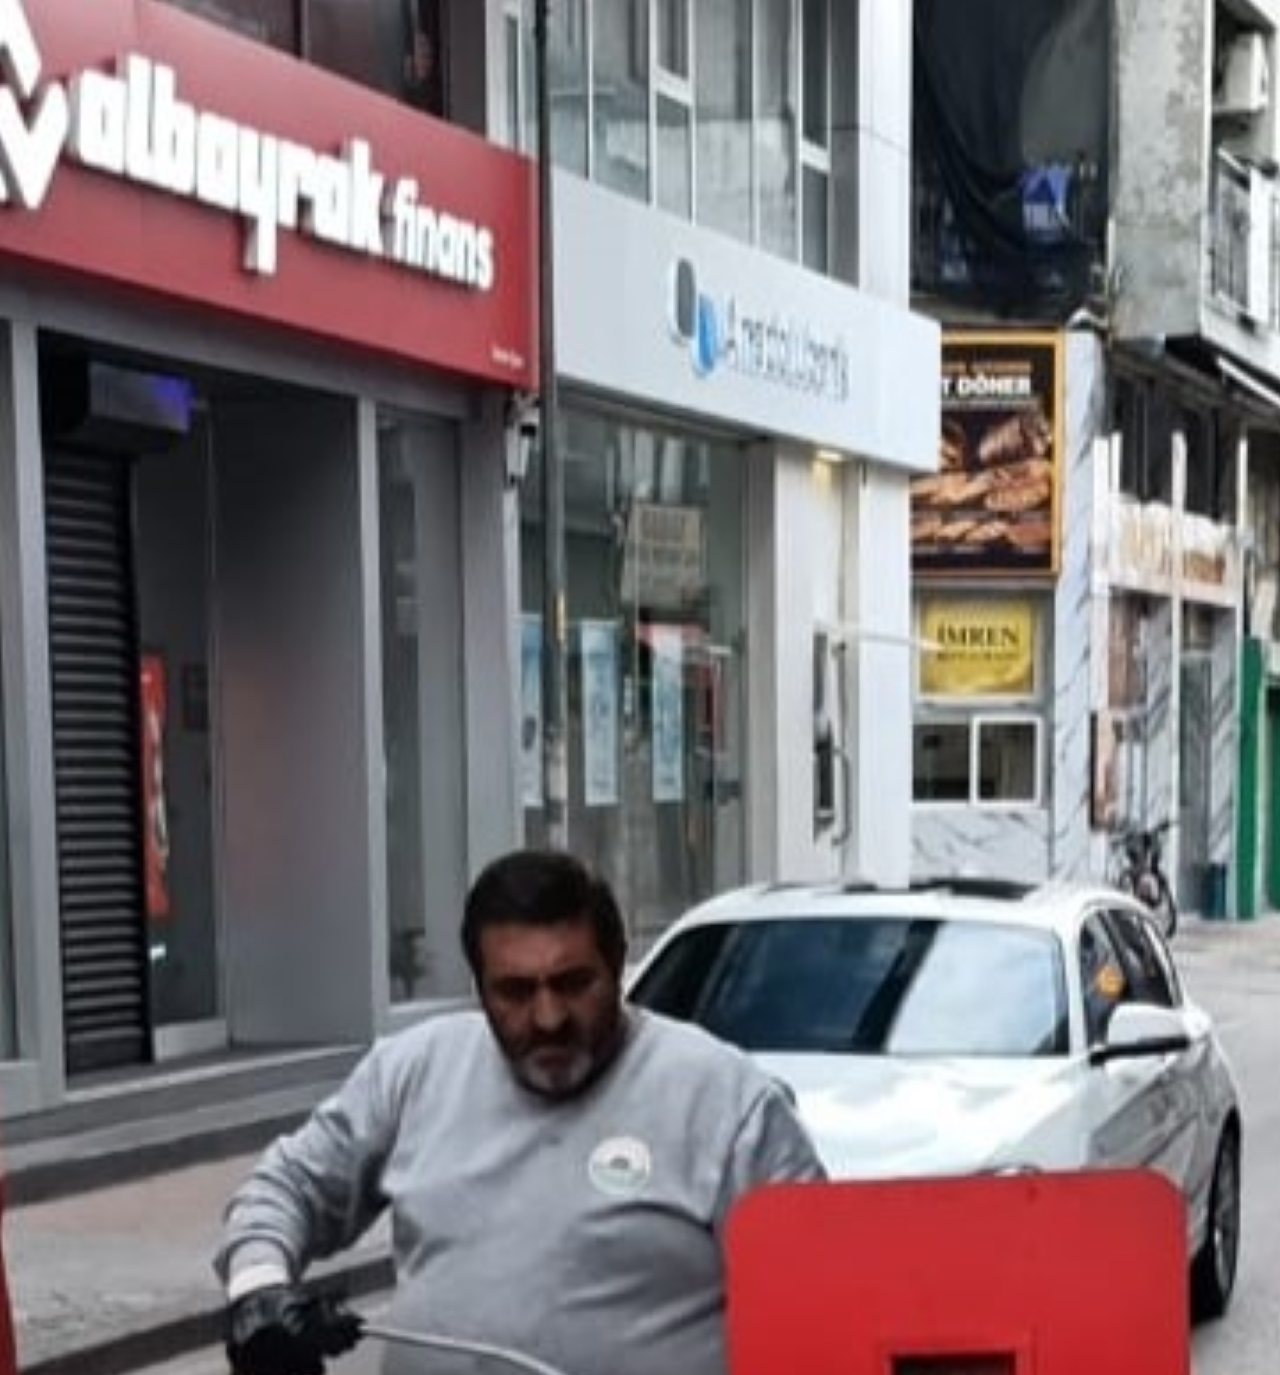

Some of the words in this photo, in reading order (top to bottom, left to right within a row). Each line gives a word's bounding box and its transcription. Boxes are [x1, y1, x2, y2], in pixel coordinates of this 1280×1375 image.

[74, 54, 386, 275] albayrak
[391, 174, 495, 291] finans
[957, 371, 1032, 396] DÖNER
